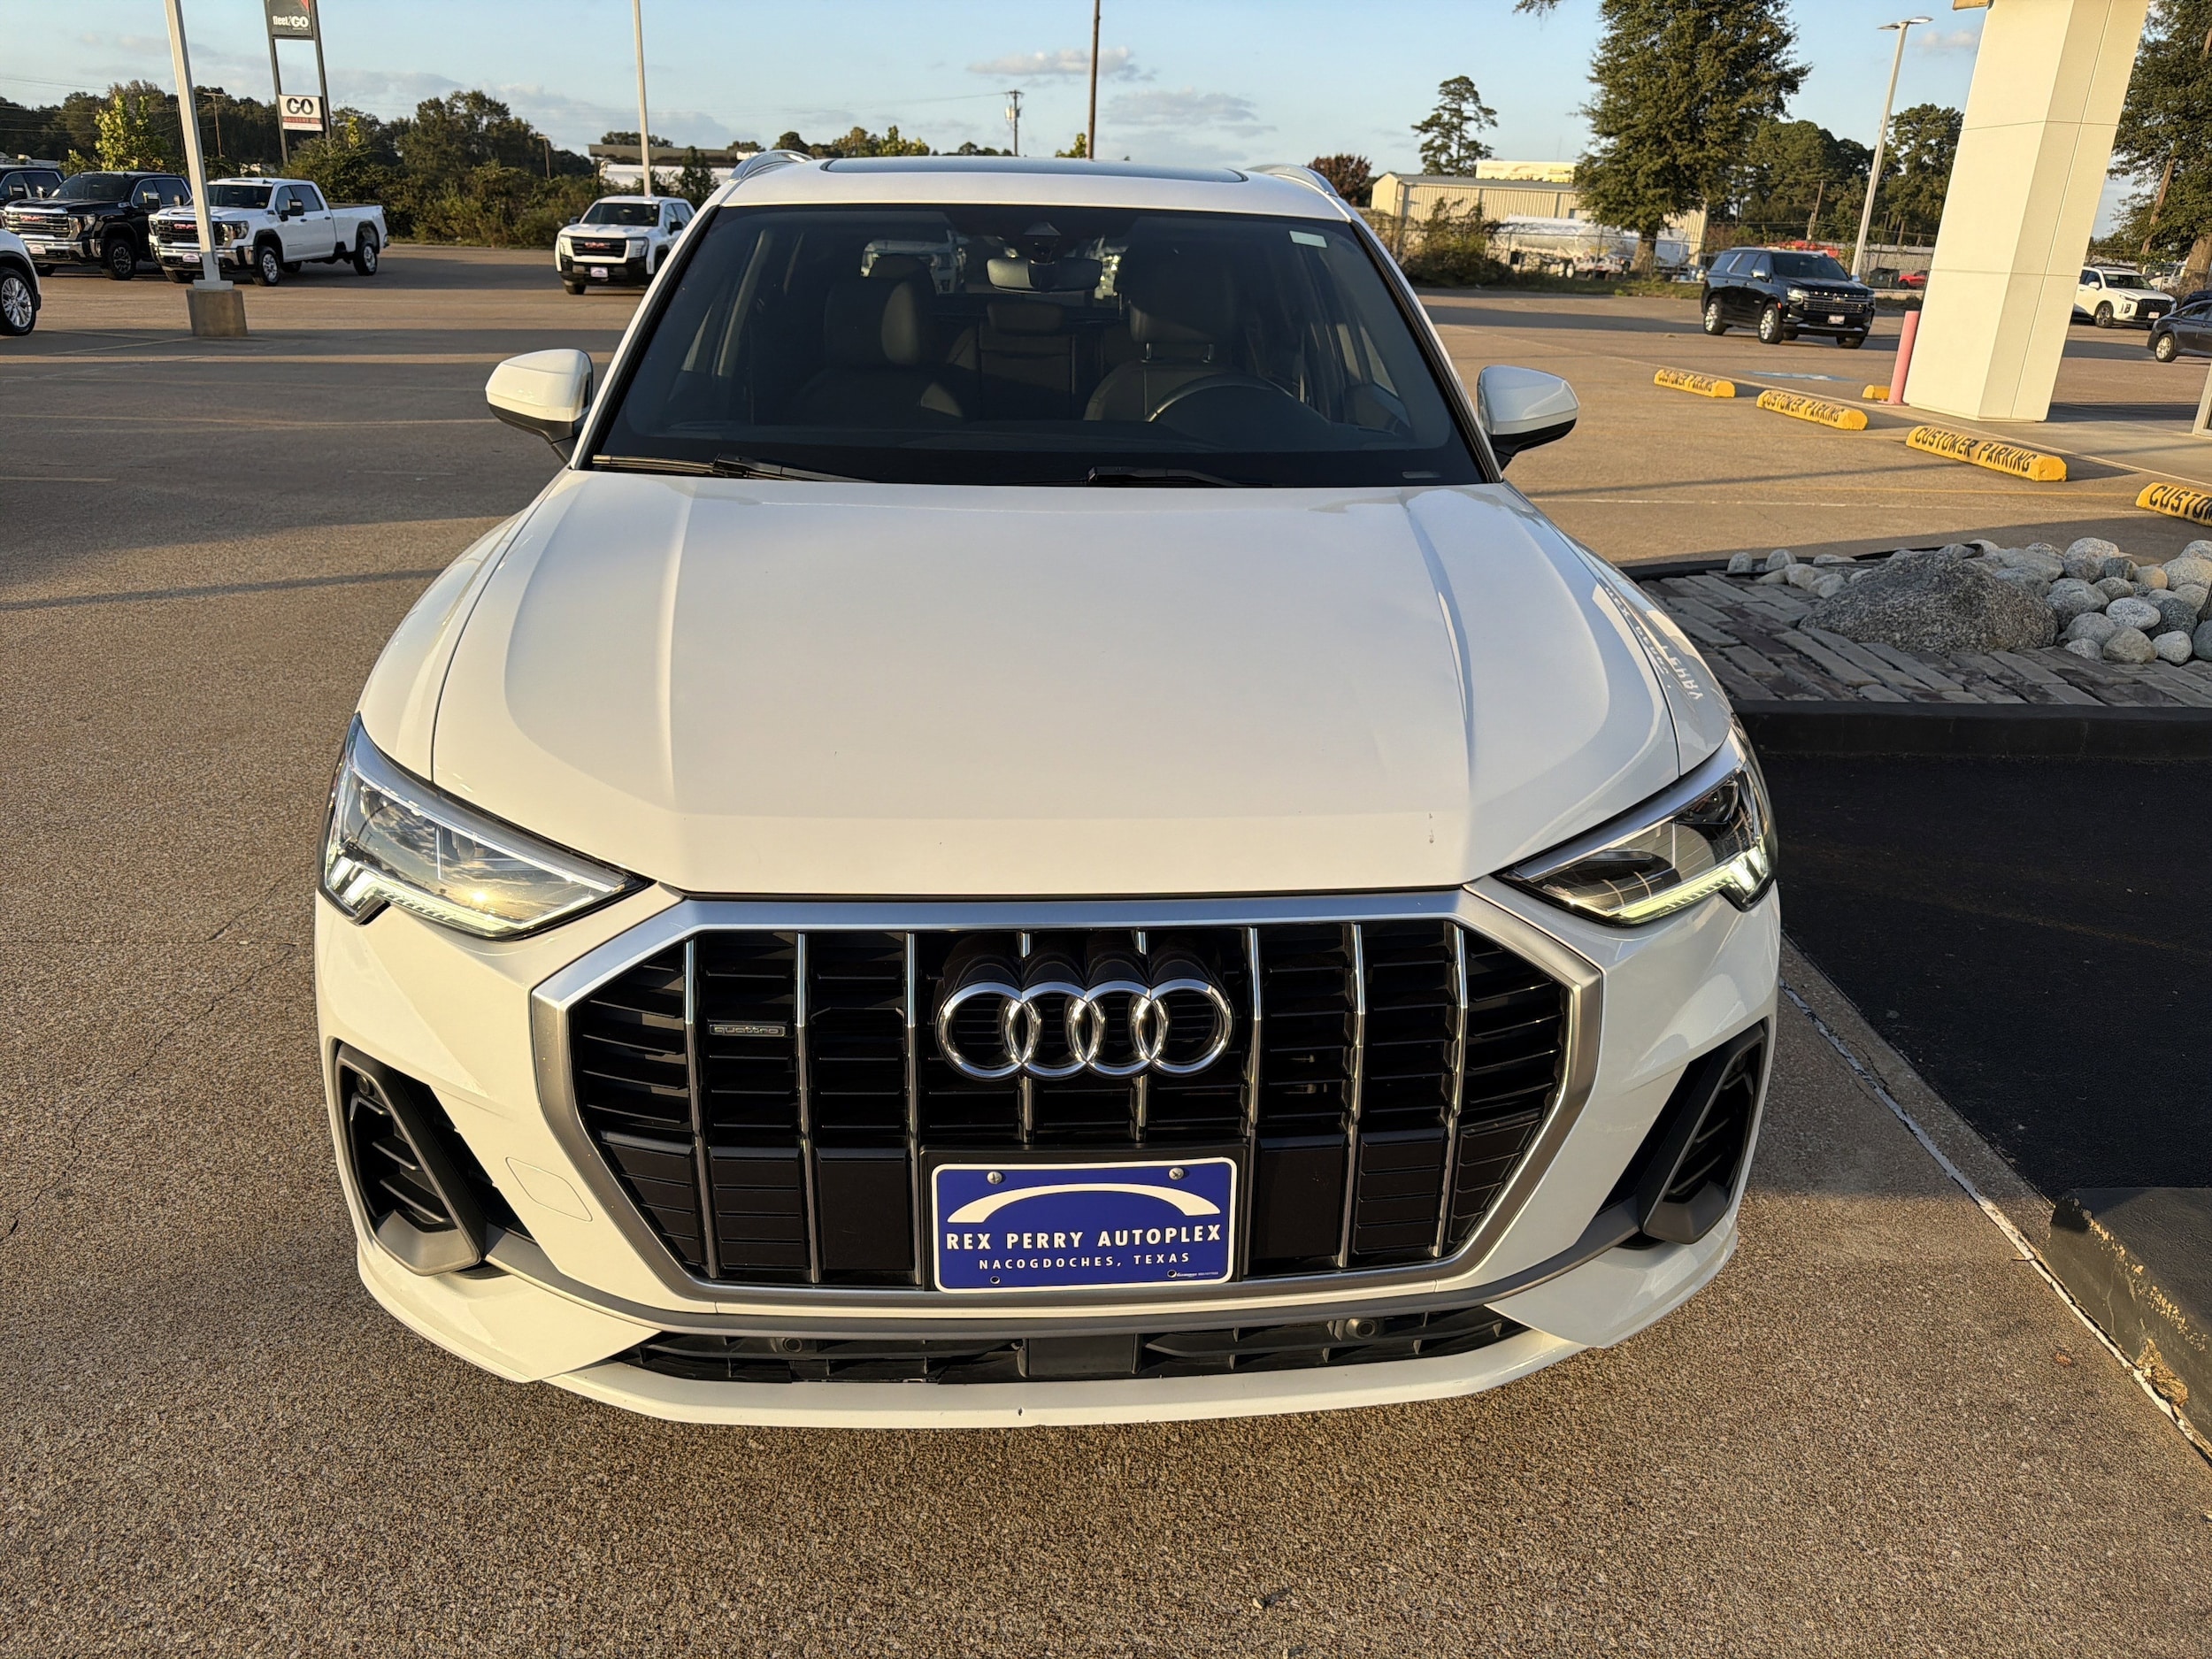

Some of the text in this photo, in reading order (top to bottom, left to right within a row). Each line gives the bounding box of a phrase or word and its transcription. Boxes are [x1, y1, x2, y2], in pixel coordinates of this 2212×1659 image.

[287, 97, 314, 115] GO
[1763, 391, 1845, 423] CUSTOMER PARKING
[1915, 426, 2037, 472] CUSTOMER PARKING
[946, 1224, 1221, 1250] REX PERRY AUTOPLEX
[979, 1252, 1190, 1270] NACOGDOCHES, TEXAS
